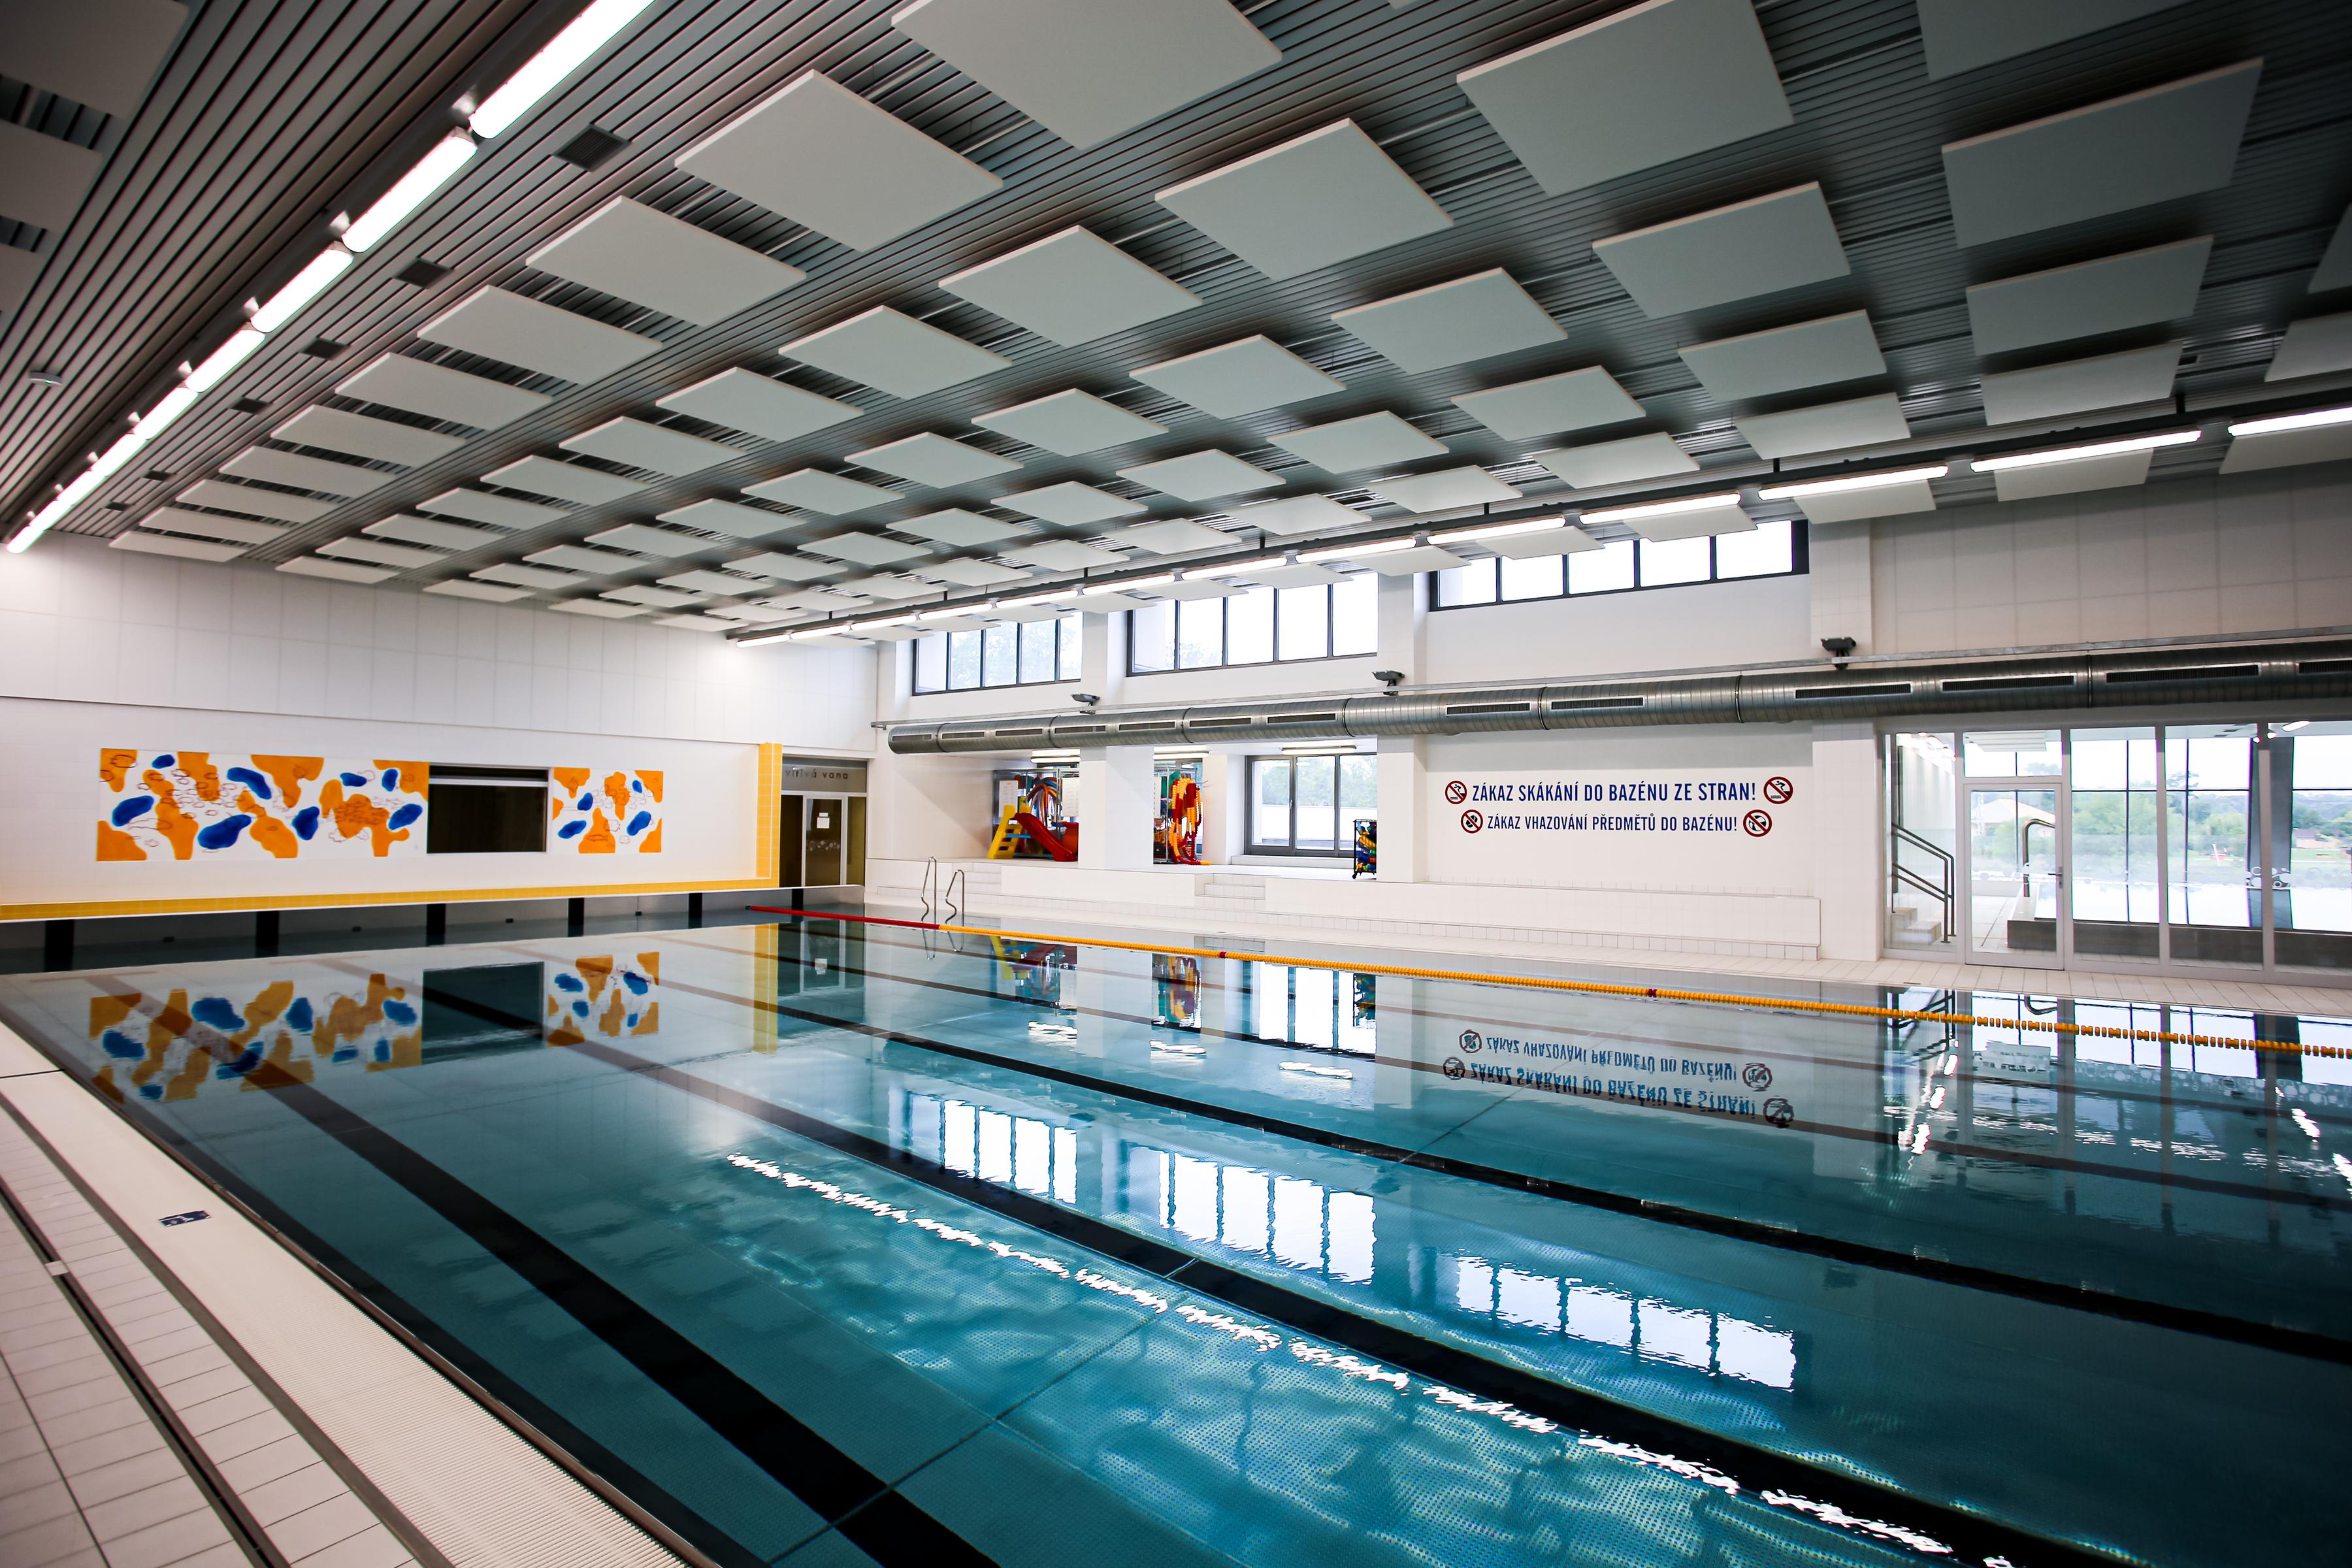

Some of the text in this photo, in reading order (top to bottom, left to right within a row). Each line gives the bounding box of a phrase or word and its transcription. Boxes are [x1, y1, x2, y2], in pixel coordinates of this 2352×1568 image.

[1472, 780, 1756, 802] ZÁKAZ SKÁKÁNÍ DO BAZÉNU ZE STRAN!
[1487, 813, 1737, 832] ZÁKAZ VHAZOVÁNÍ PŘEDMĚTŮ DO BAZÉNU!
